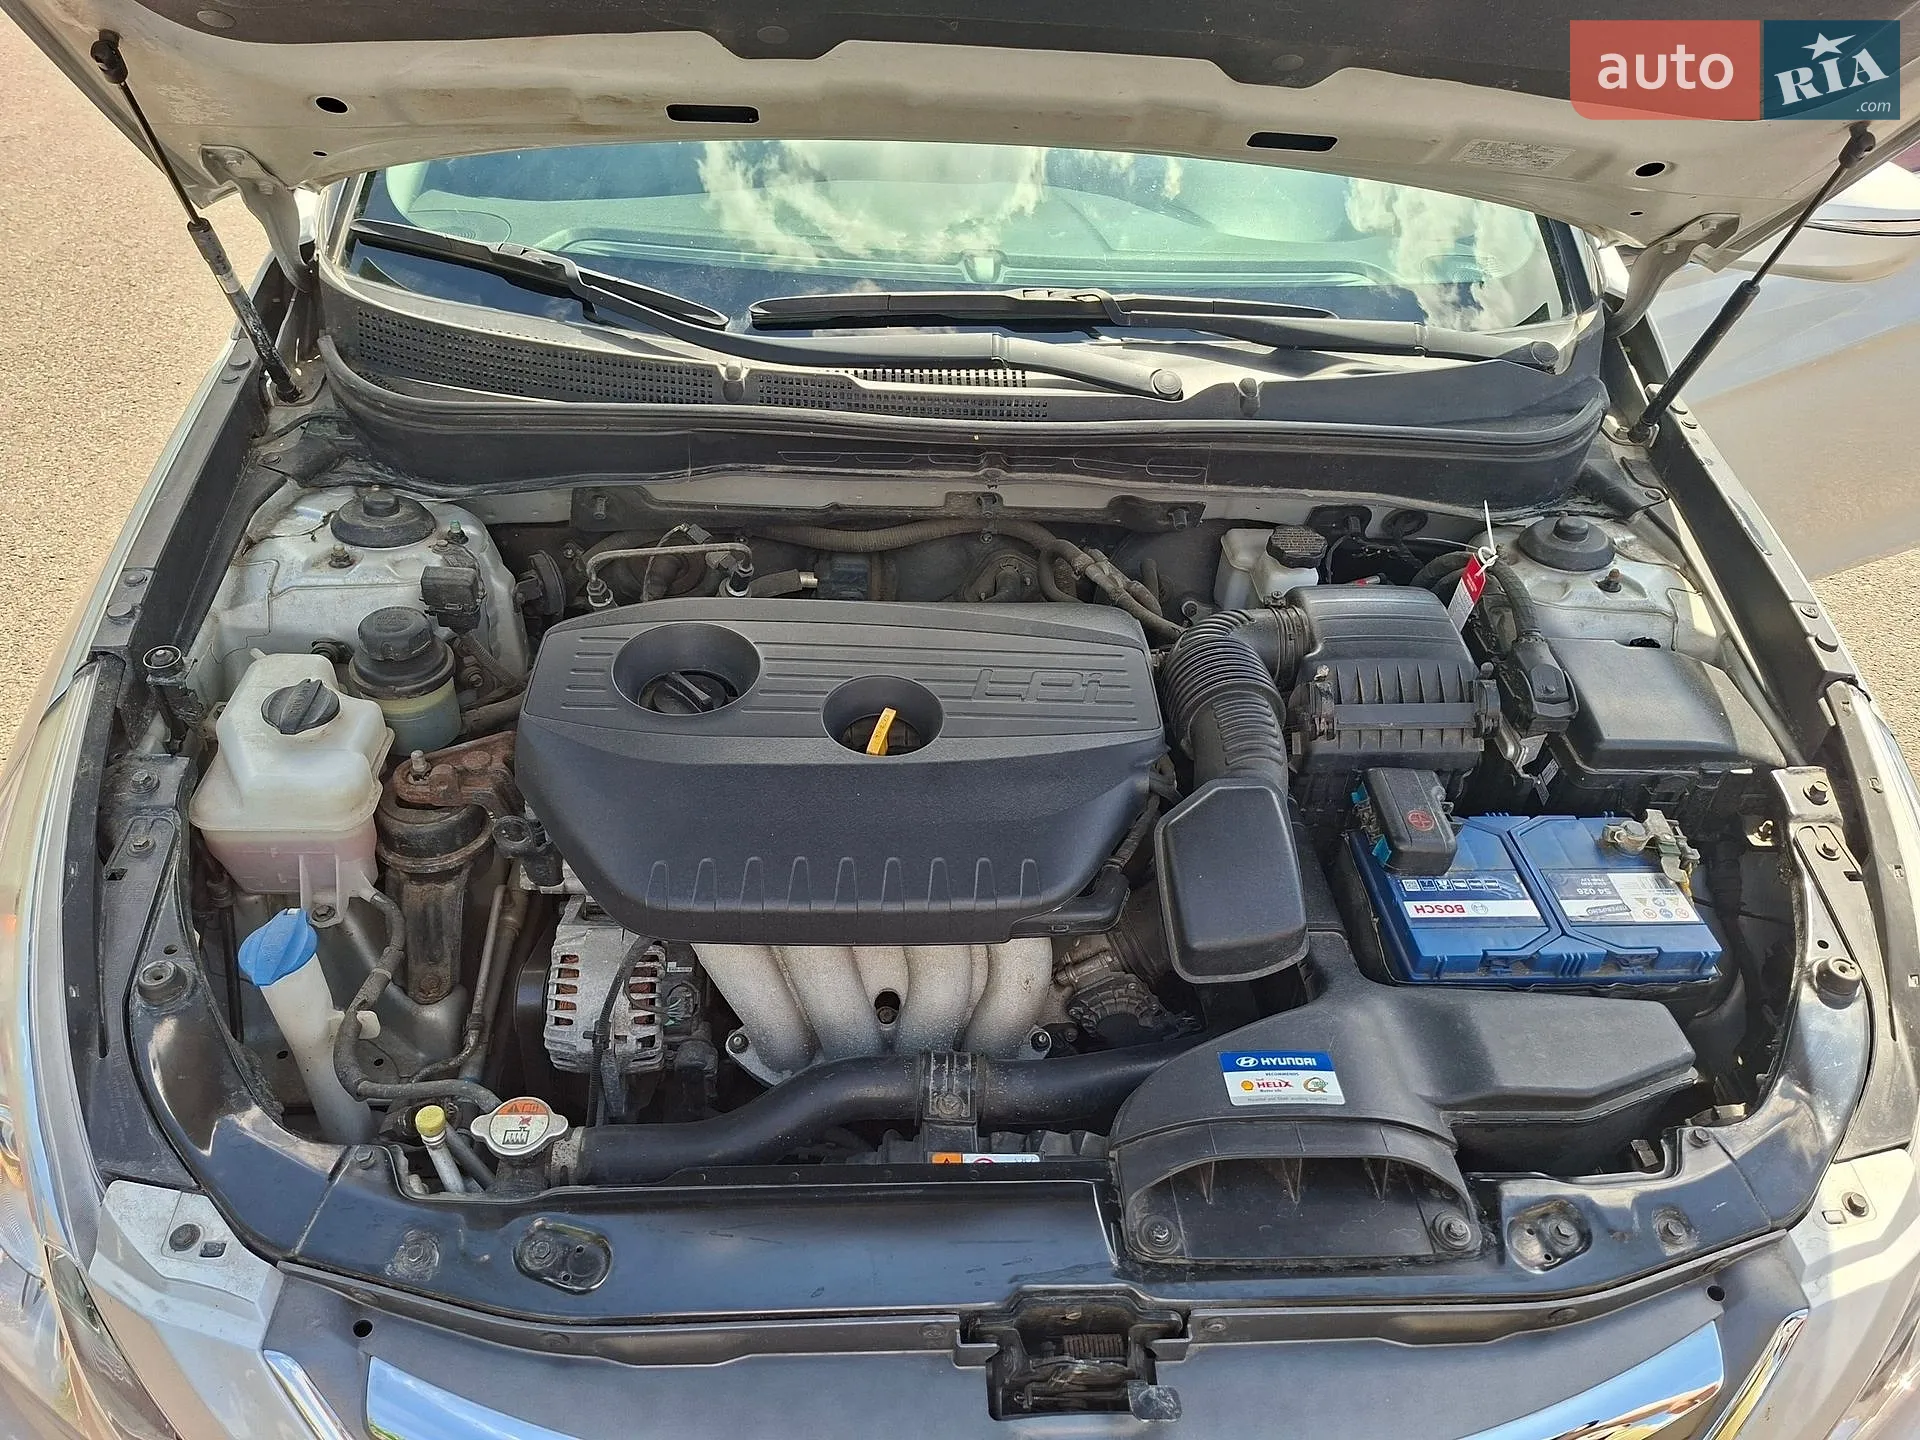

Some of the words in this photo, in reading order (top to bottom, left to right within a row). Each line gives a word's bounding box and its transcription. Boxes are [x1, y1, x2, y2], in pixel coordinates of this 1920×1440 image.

[1413, 904, 1466, 914] BOSCH
[1261, 1057, 1317, 1066] HYUNDAI
[1257, 1080, 1293, 1088] HELIX
